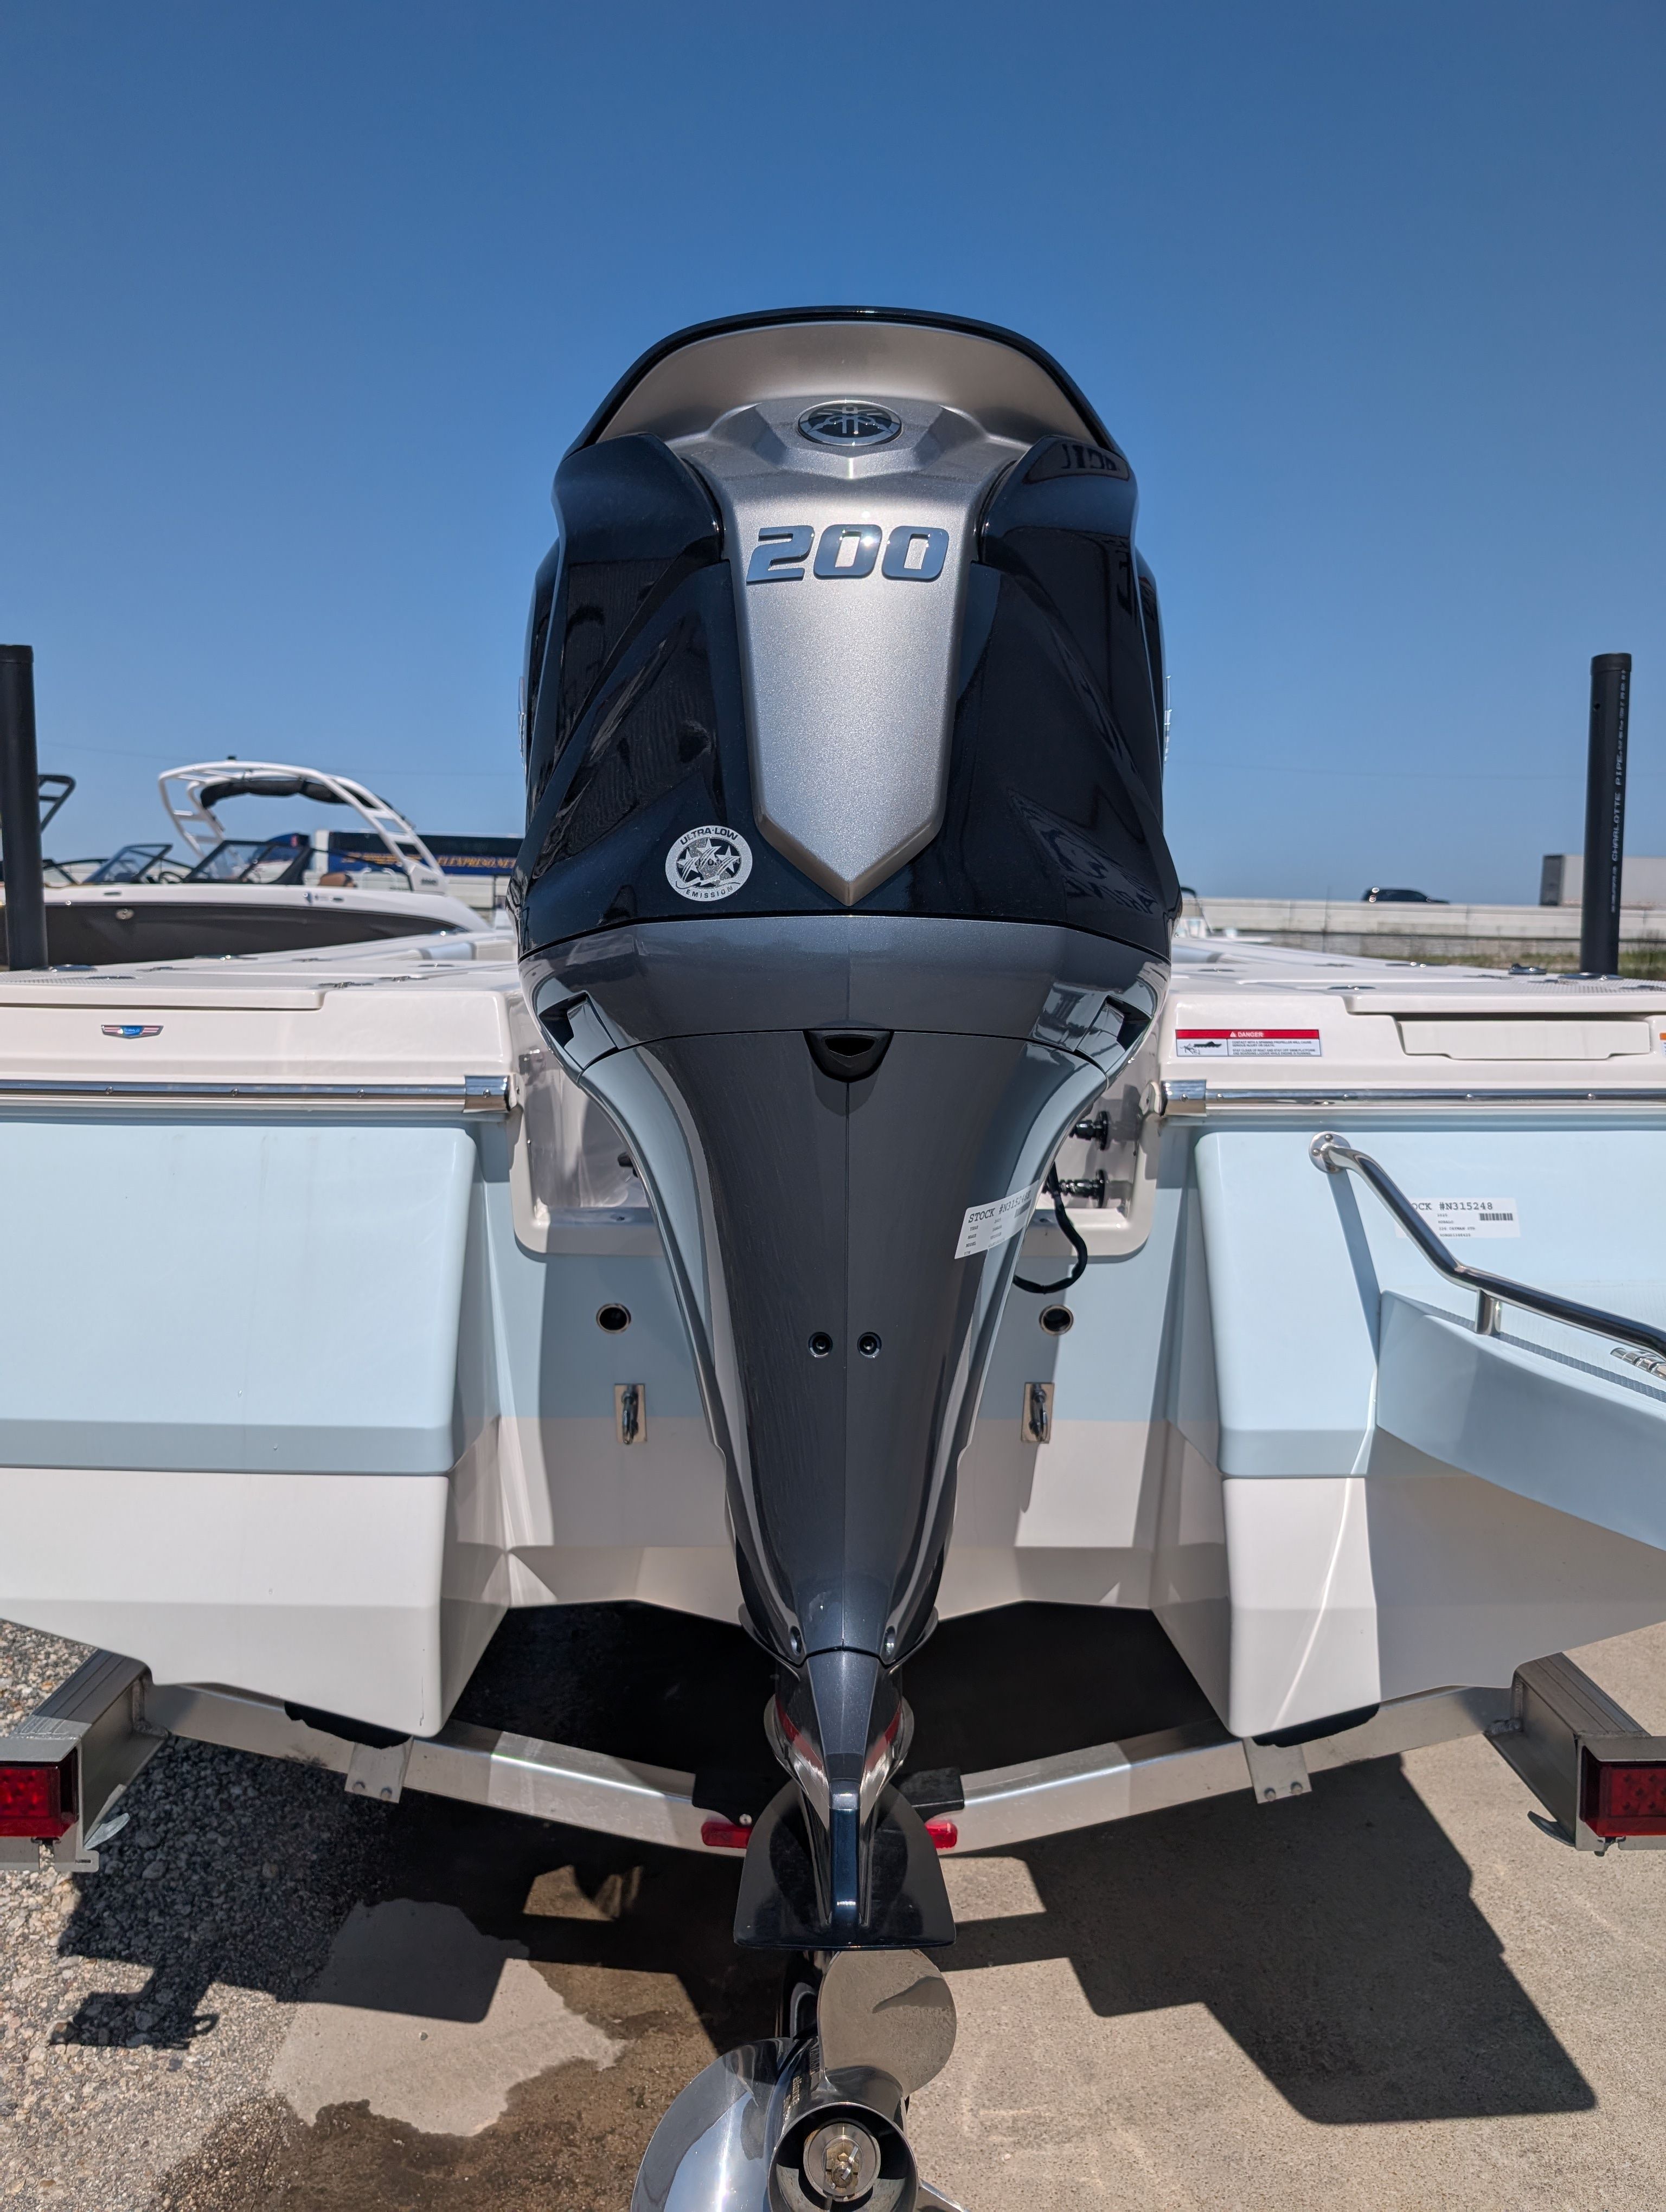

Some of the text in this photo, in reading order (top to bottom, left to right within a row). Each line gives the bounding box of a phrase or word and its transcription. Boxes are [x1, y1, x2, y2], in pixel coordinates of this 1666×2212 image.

[746, 524, 950, 586] 200
[1612, 792, 1621, 861] CHARLOTTE
[686, 886, 733, 898] EMISSION
[1439, 1201, 1493, 1211] #N315248
[968, 1207, 995, 1224] STOCK
